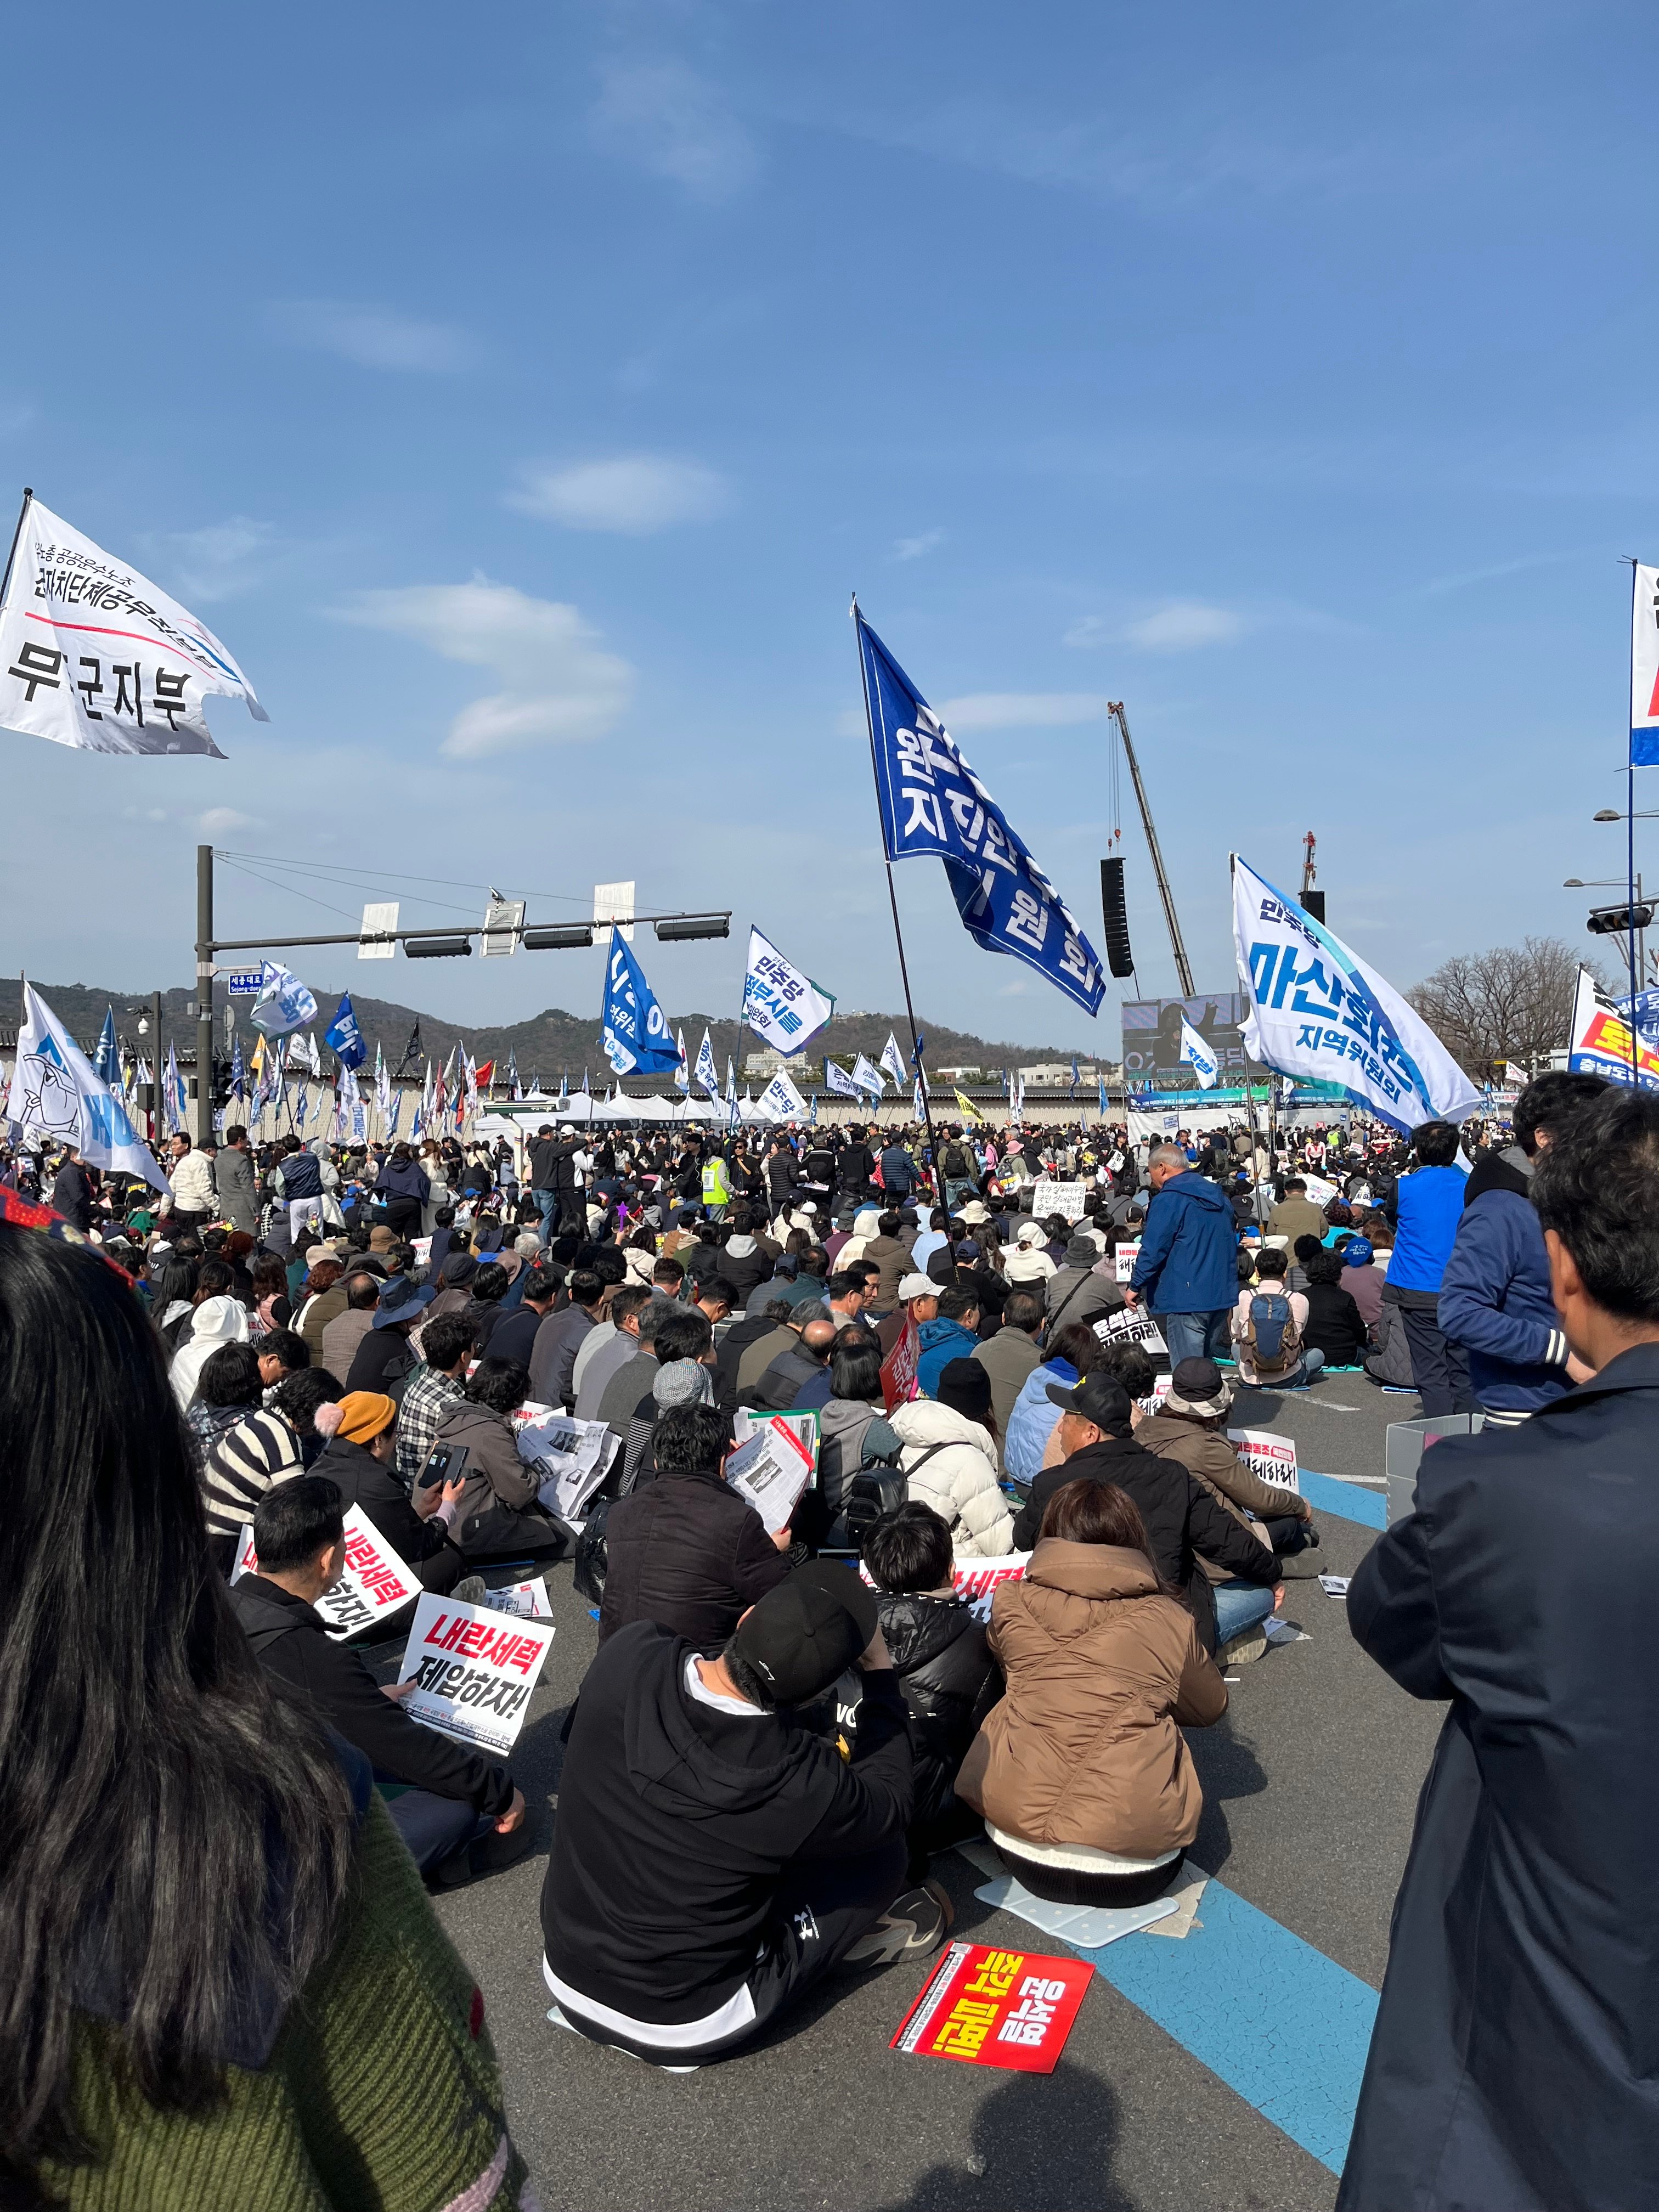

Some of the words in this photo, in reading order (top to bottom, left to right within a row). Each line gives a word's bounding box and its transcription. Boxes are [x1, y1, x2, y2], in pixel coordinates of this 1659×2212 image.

[8, 641, 192, 731] 무군지부
[1260, 898, 1319, 949] 민주당
[231, 975, 261, 985] 세종대로
[754, 956, 805, 1001] 민주당
[746, 974, 803, 1035] 정부시을
[1296, 1024, 1402, 1105] 지역위원회
[769, 1080, 795, 1113] 민주당
[1036, 1195, 1052, 1204] 국민
[1039, 1184, 1052, 1193] 국가
[1242, 1457, 1295, 1487] 체하라!
[323, 1581, 376, 1627] 하자!
[424, 1614, 545, 1675] 내란세력
[407, 1655, 531, 1720] 제압하자!
[963, 1950, 1025, 1997] 즉각
[932, 1997, 1000, 2058] 파면!
[997, 1976, 1066, 2046] 윤석열
